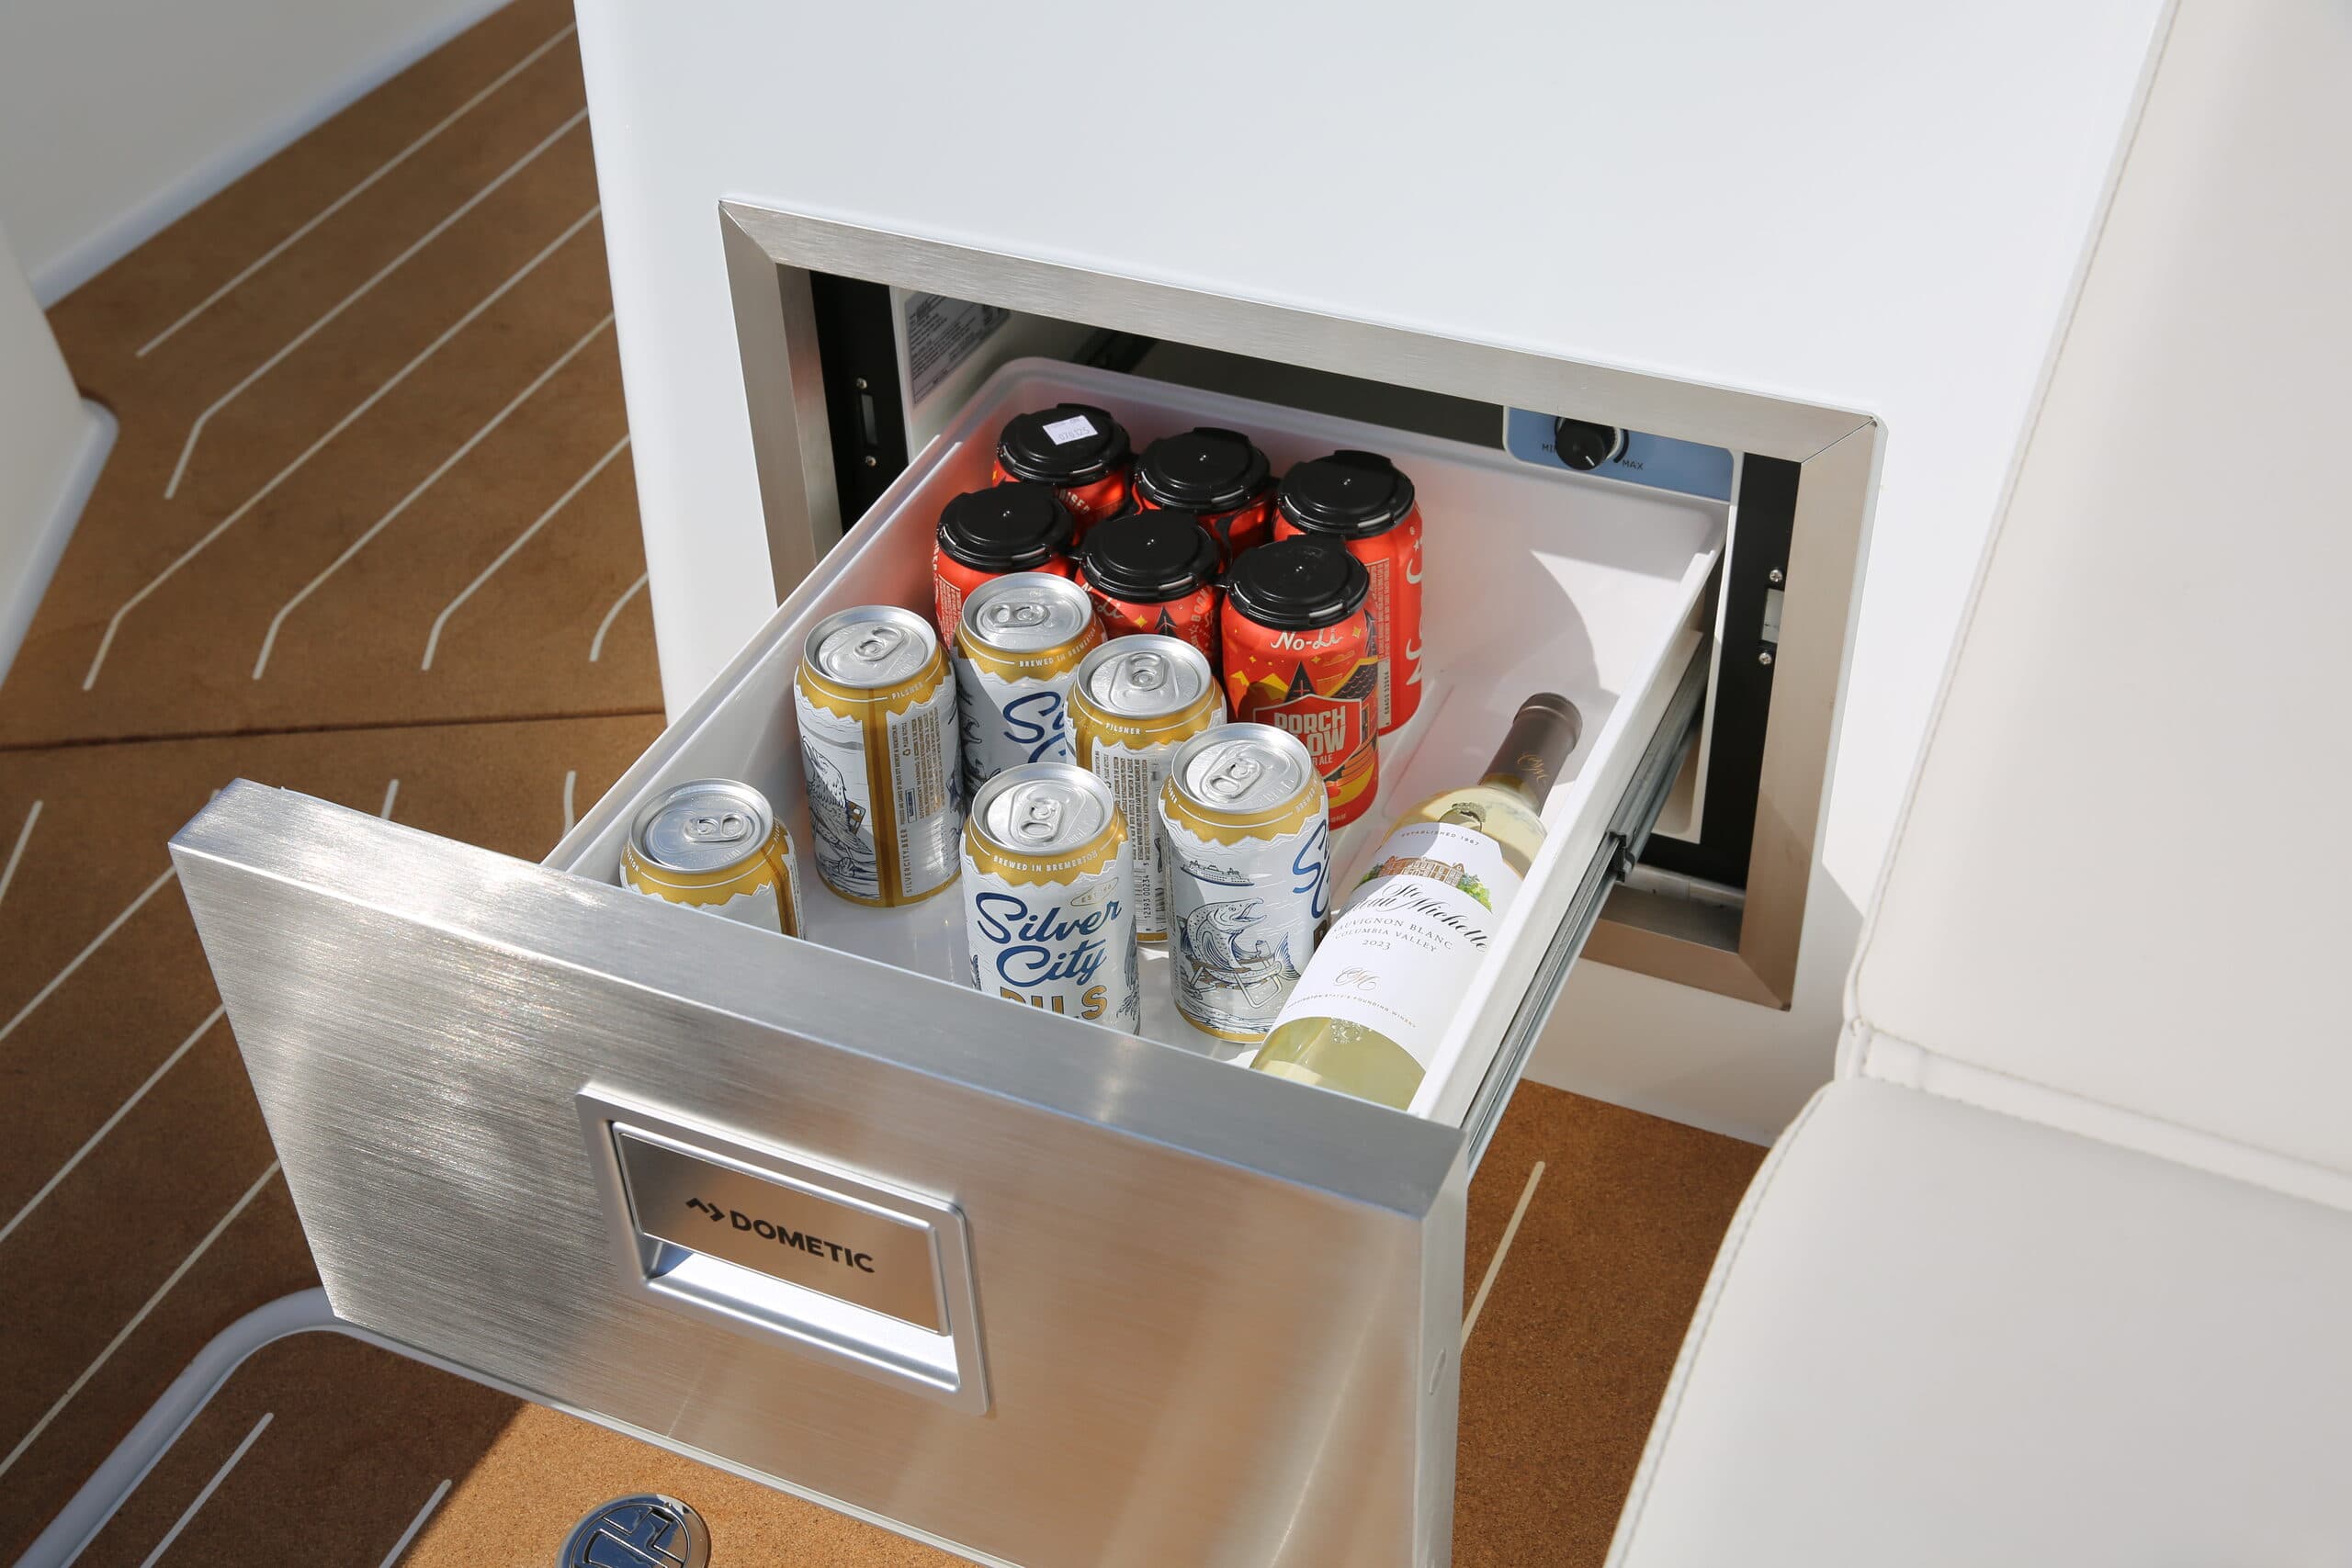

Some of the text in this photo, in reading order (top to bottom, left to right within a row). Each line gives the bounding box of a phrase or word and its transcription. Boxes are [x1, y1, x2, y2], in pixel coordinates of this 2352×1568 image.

[1623, 459, 1644, 471] MAX
[1270, 626, 1344, 651] No-Li
[1019, 658, 1054, 668] BREWED
[1104, 721, 1142, 735] PILSNER
[1273, 705, 1346, 735] PORCH
[1306, 726, 1346, 756] OW
[1319, 753, 1333, 765] ALE
[993, 850, 1099, 873] BREWED IN BREMERTON
[975, 892, 1123, 944] Silver
[1376, 897, 1489, 953] Michelle
[1334, 928, 1438, 953] COLUMBIA VALLEY
[1362, 939, 1391, 952] 2023
[1408, 923, 1454, 950] BLANC
[996, 939, 1108, 987] City
[1352, 996, 1389, 1012] FOUNDING
[729, 1209, 876, 1274] DOMETIC
